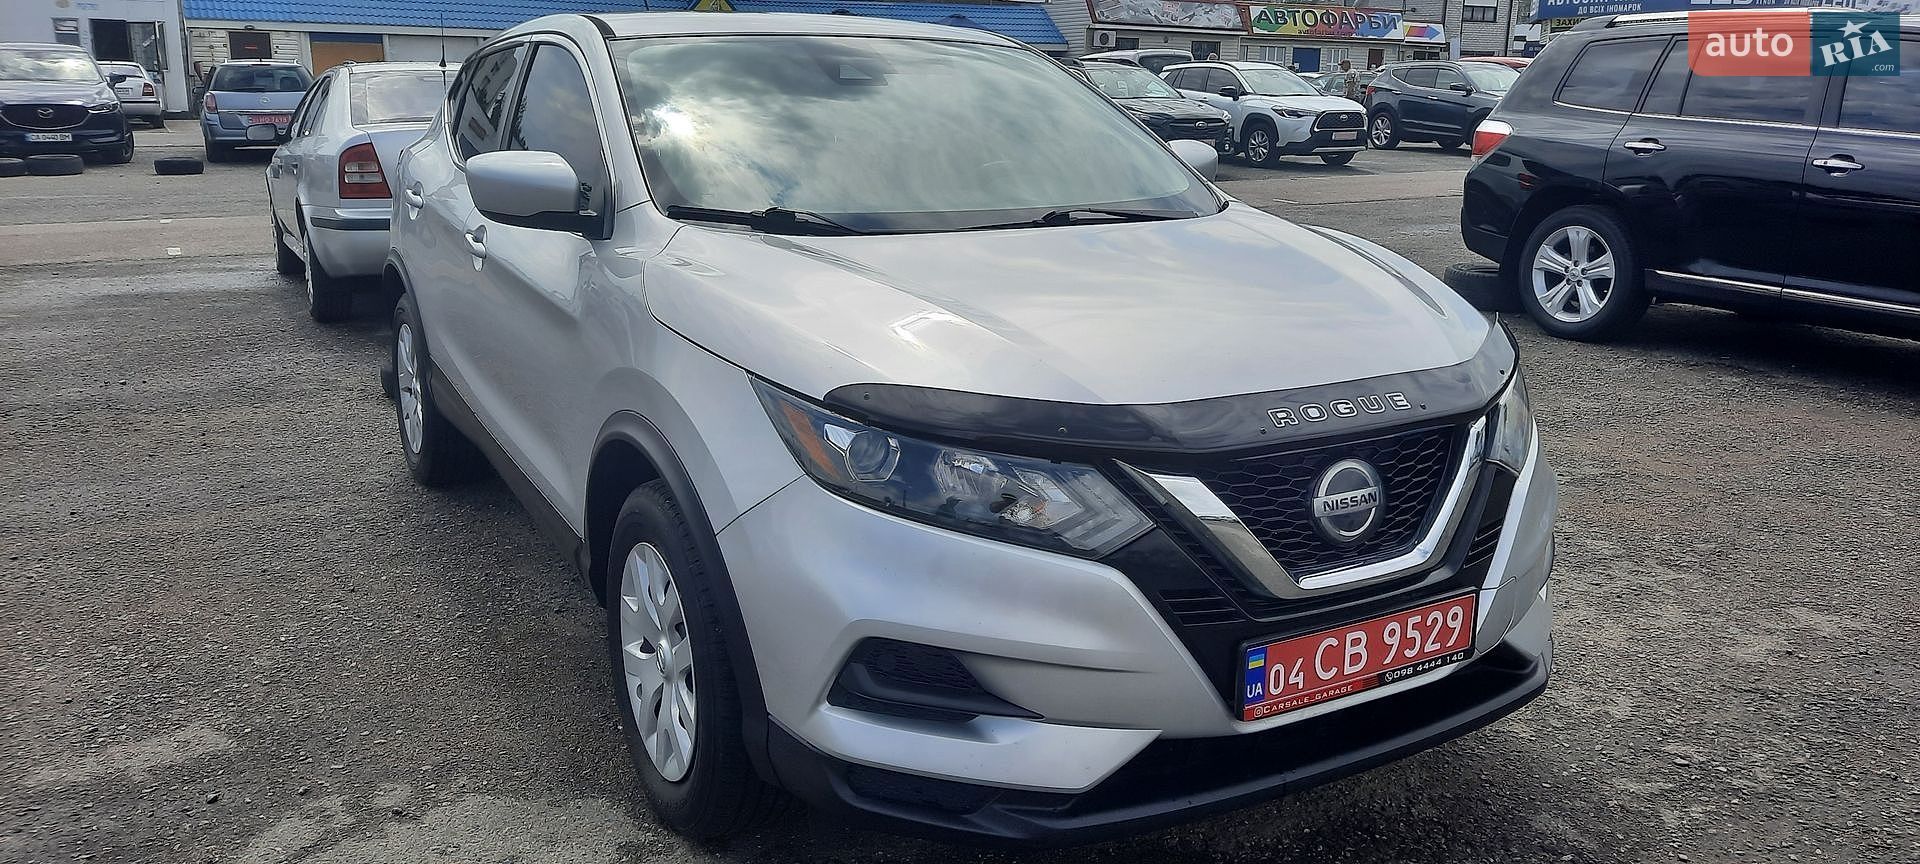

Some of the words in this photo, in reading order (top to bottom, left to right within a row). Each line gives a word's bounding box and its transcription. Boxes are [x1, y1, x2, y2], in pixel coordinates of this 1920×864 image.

[1256, 9, 1398, 30] АВТОФАРБИ
[1577, 7, 1588, 15] ДО
[1606, 3, 1642, 13] ІНОМАРОК
[1267, 391, 1412, 428] ROGUE
[1322, 491, 1378, 513] NISSAN
[1268, 657, 1305, 696] 04
[1314, 630, 1368, 681] CB
[1382, 605, 1464, 665] 9529
[1393, 667, 1413, 679] 098
[1416, 659, 1442, 672] 4444
[1447, 652, 1464, 663] 140
[1247, 683, 1263, 698] UA
